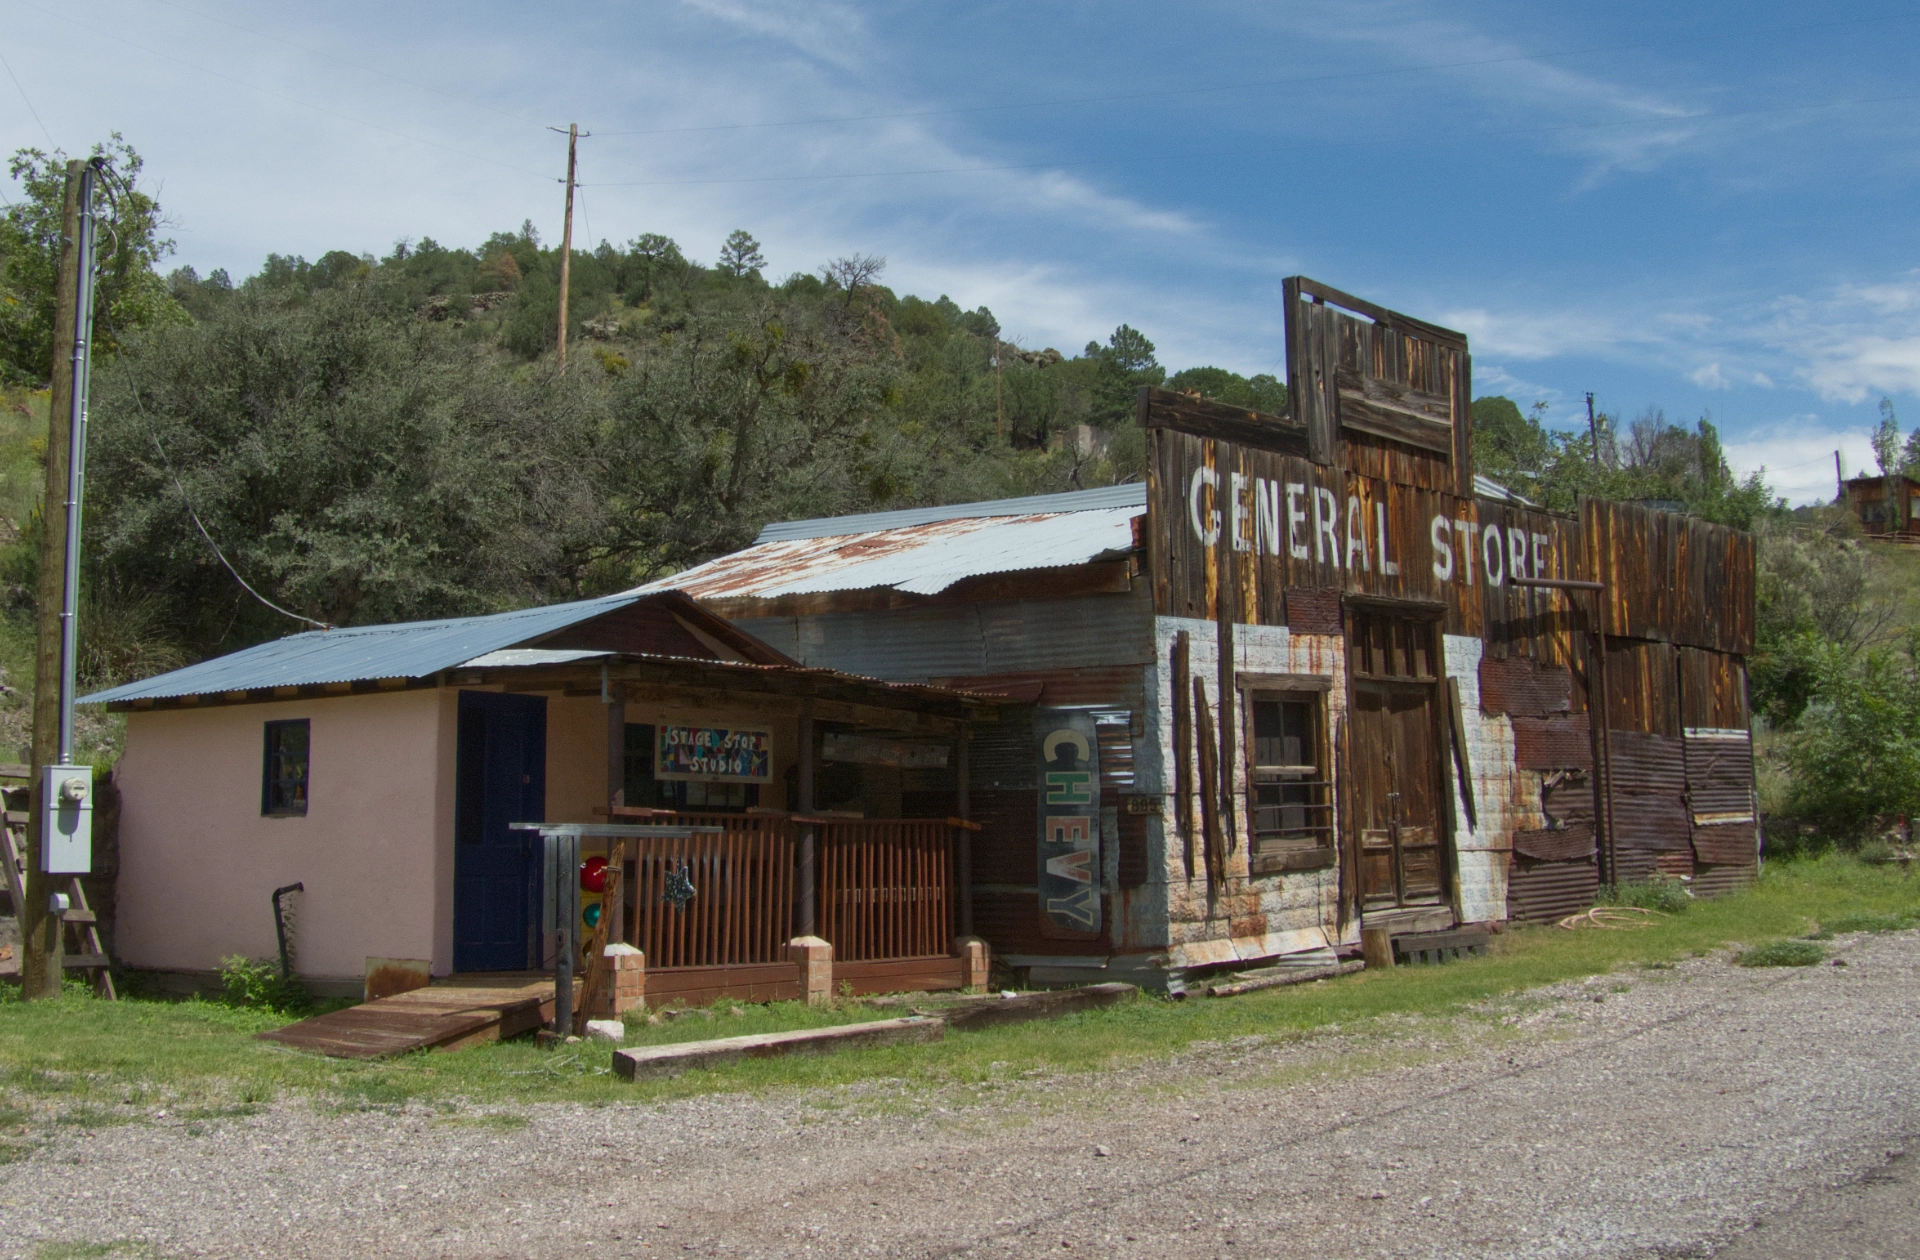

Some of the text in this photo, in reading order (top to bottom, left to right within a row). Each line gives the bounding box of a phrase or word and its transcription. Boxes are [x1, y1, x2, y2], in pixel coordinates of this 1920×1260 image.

[1189, 466, 1551, 593] GENERAL STORE
[670, 730, 756, 749] STAGE STOP
[689, 756, 742, 773] STUDIO
[1043, 729, 1093, 926] CHEVY
